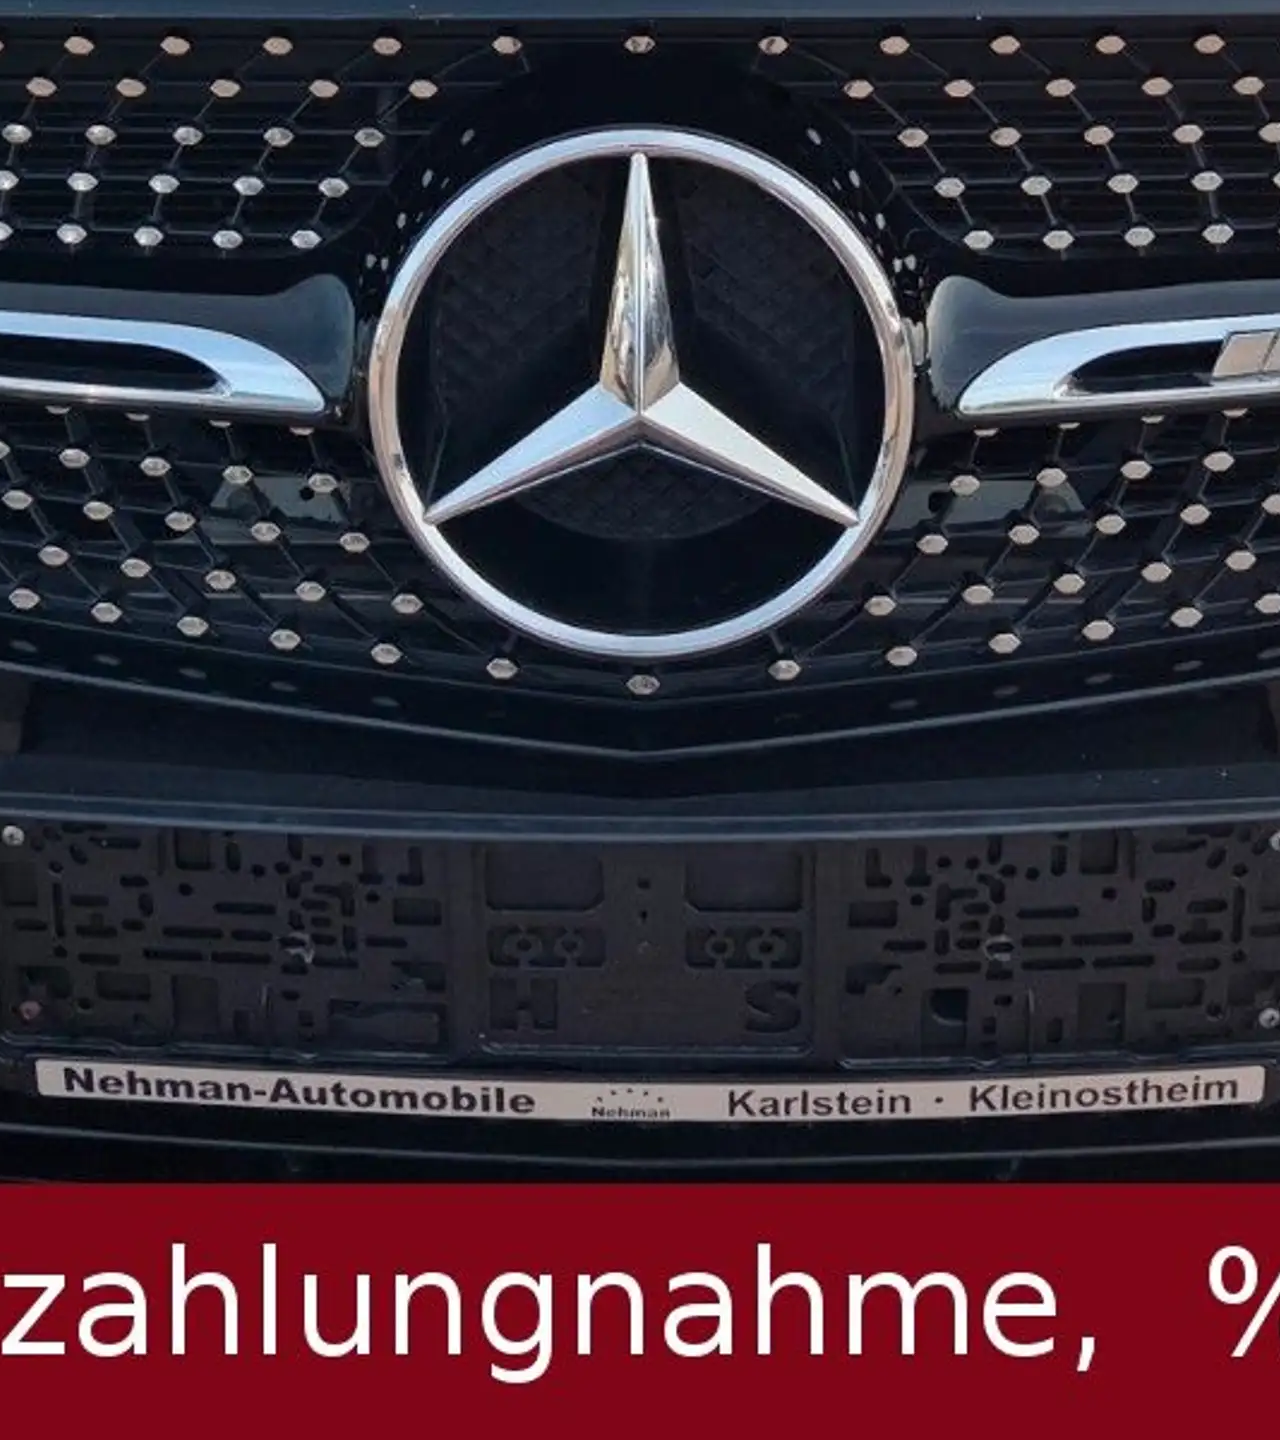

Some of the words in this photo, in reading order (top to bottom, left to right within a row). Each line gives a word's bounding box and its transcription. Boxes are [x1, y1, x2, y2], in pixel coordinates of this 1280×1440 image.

[63, 1066, 536, 1115] Nehman-Automobile
[591, 1106, 671, 1118] Nehman
[727, 1089, 913, 1118] Karlstein
[968, 1074, 1239, 1114] Kleinostheim
